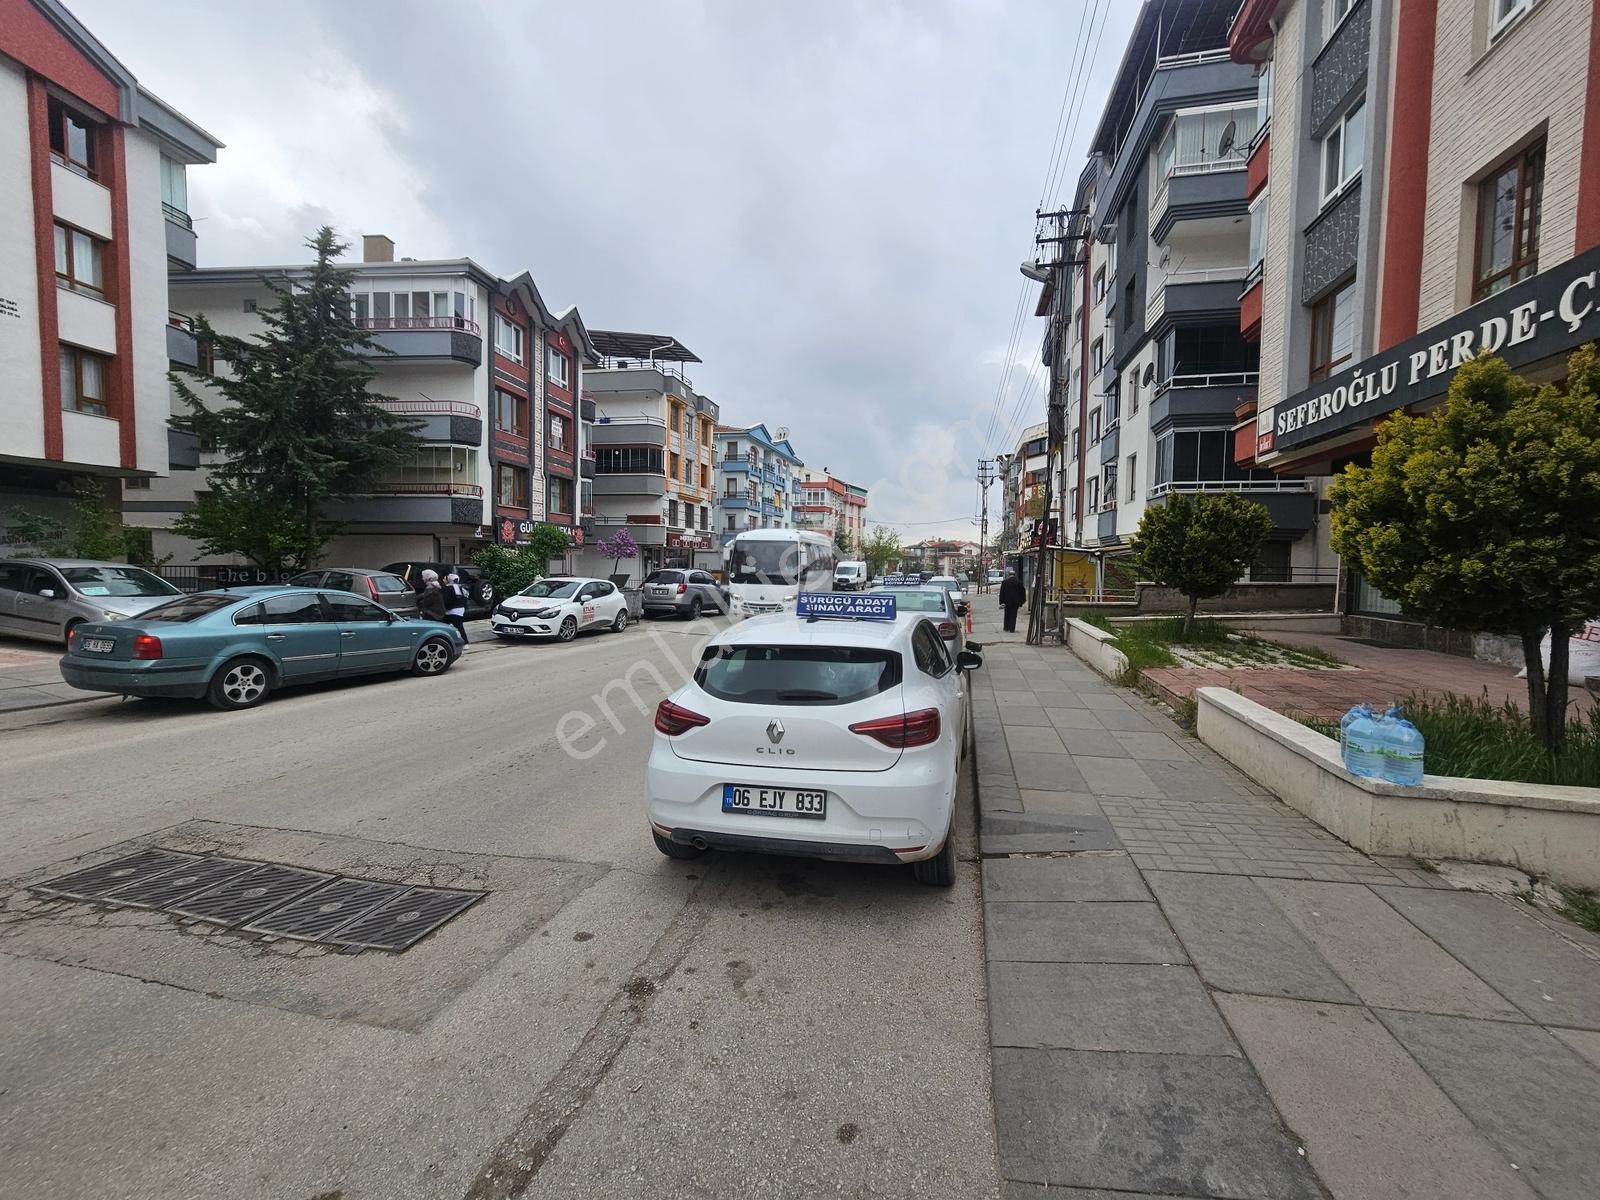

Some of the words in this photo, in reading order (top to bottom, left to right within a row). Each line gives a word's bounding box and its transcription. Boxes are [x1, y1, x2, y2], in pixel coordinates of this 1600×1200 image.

[1276, 361, 1400, 437] SEFEROĞLU
[1407, 271, 1600, 386] PERDE-Ç
[218, 567, 249, 582] the
[800, 595, 851, 605] SÜRÜCÜ
[854, 598, 893, 606] ADAYI
[806, 604, 843, 612] SINAV
[846, 605, 886, 613] ARACI
[756, 747, 796, 755] CLIO
[733, 788, 750, 807] 06
[759, 790, 786, 809] EJY
[795, 792, 823, 812] 833
